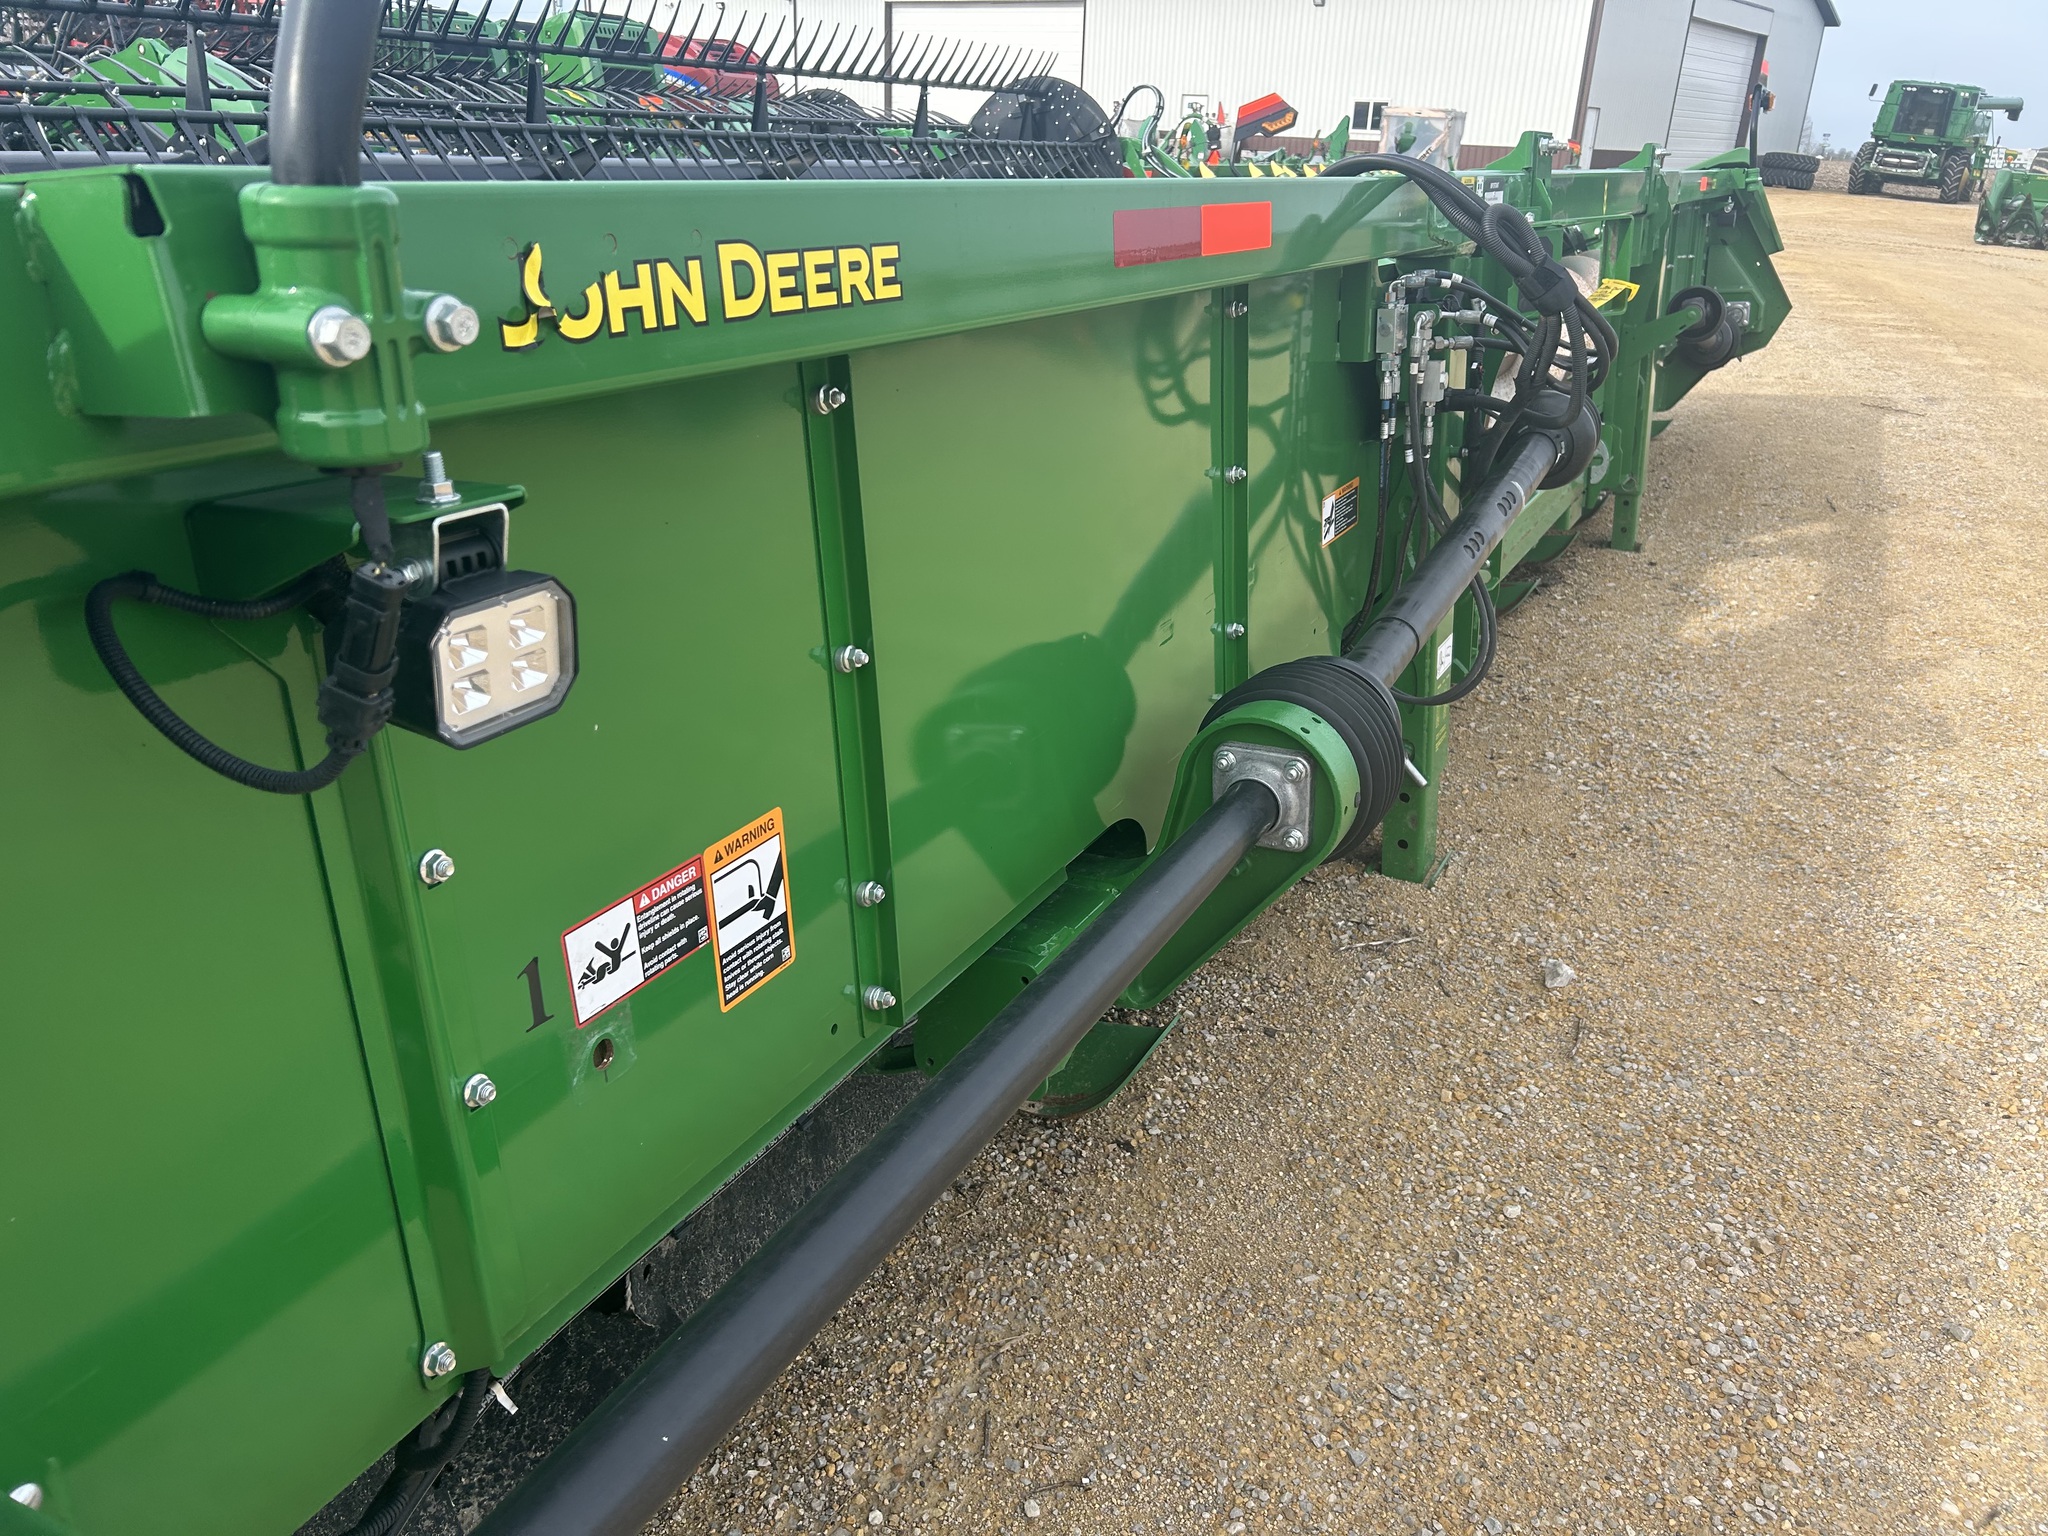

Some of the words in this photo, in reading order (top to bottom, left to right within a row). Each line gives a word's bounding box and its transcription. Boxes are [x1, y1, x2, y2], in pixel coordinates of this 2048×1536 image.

[498, 240, 710, 352] JOHN
[714, 238, 902, 324] DEERE
[724, 818, 775, 856] WARNING
[651, 866, 697, 901] DANGER
[636, 898, 672, 923] Entanglement
[676, 884, 696, 899] rotating
[637, 914, 660, 931] driveline
[660, 908, 670, 917] can
[669, 899, 685, 912] cause
[684, 888, 703, 903] serious
[639, 926, 654, 939] injury
[660, 912, 677, 926] death.
[641, 942, 655, 955] Keep
[661, 926, 680, 941] shields
[685, 914, 700, 928] place.
[722, 950, 738, 966] Avoid
[737, 938, 756, 955] serious
[755, 928, 770, 942] injury
[769, 920, 782, 932] from
[643, 955, 659, 970] Avoid
[658, 944, 677, 960] contact
[676, 937, 688, 948] with
[644, 961, 665, 978] rotating
[663, 952, 679, 967] parts.
[723, 956, 743, 974] contact
[742, 949, 754, 961] with
[753, 936, 773, 953] rotating
[772, 927, 784, 940] stalk
[723, 967, 741, 983] knives
[746, 951, 765, 967] thrown
[764, 938, 784, 954] objects.
[725, 980, 737, 992] Stay
[736, 970, 750, 983] clear
[749, 961, 763, 974] while
[762, 953, 775, 965] corn
[725, 986, 740, 1001] head
[744, 969, 765, 987] running.
[516, 955, 555, 1034] 1
